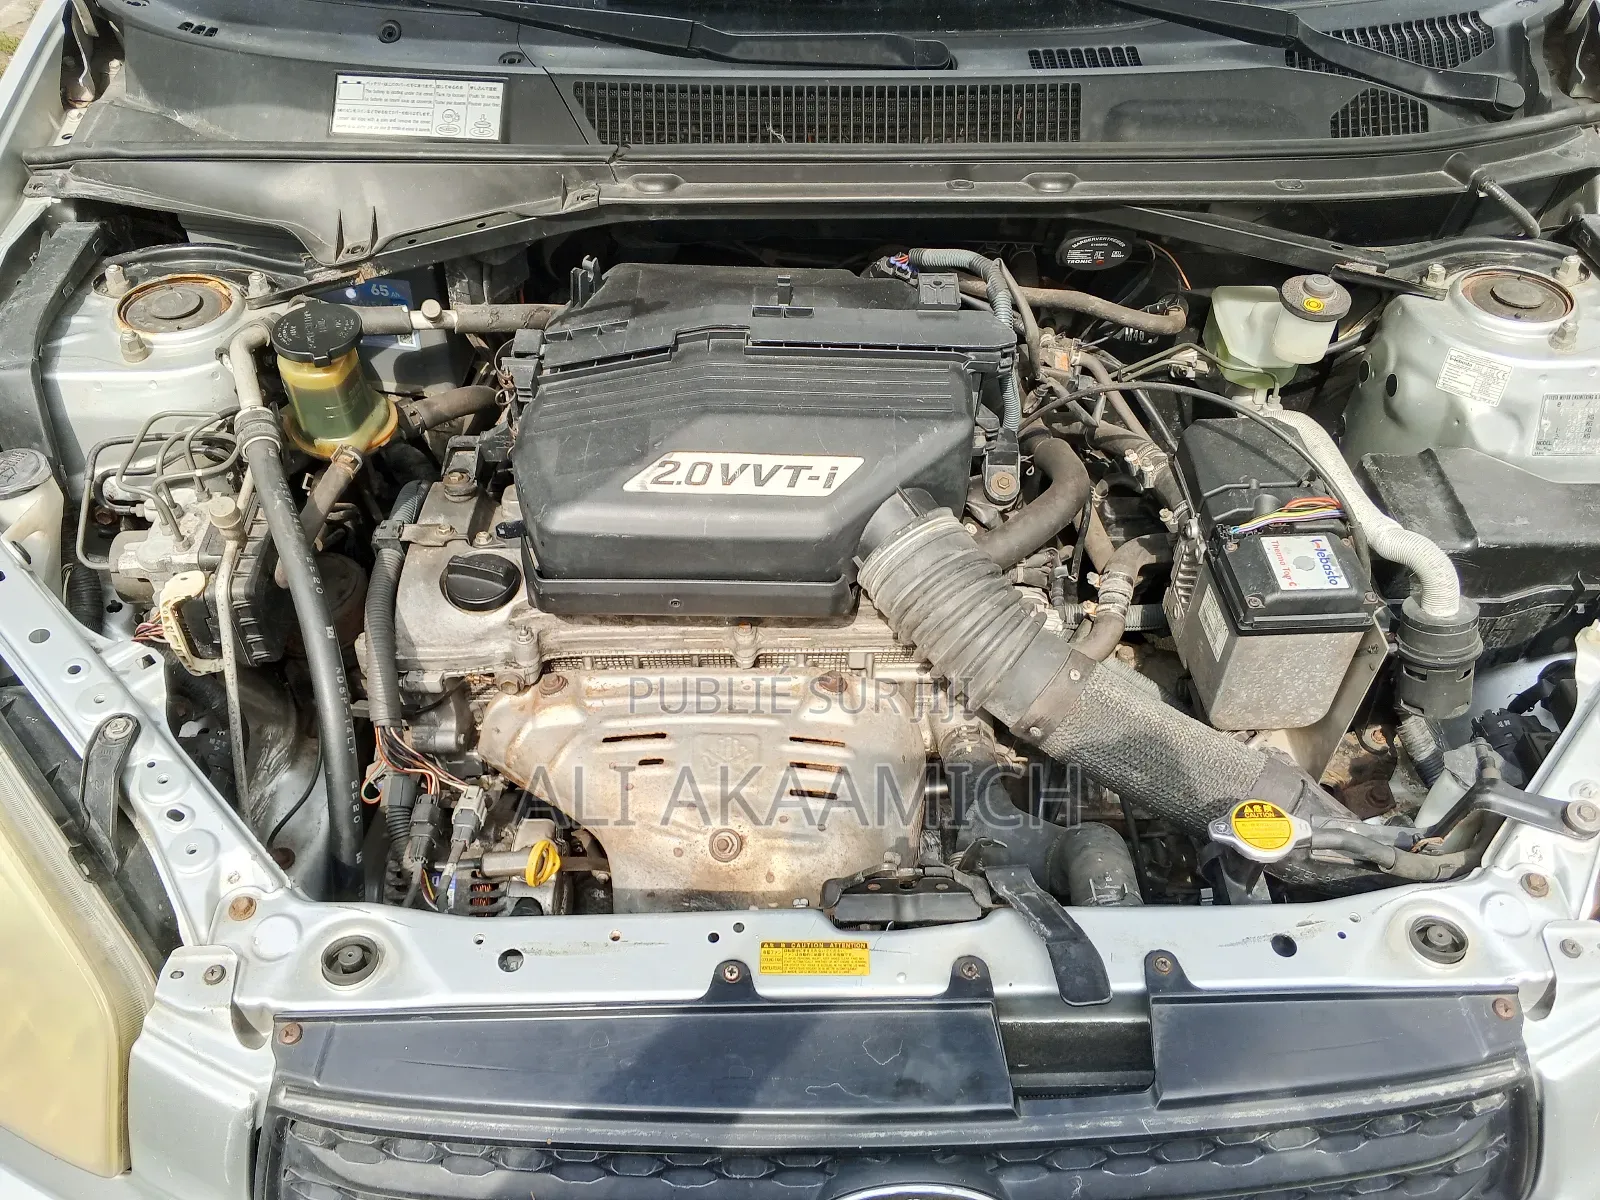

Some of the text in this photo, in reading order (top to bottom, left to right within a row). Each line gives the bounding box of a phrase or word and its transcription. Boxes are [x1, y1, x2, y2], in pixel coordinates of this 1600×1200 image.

[371, 283, 389, 297] 65
[1271, 541, 1285, 566] Thermo
[1282, 567, 1292, 581] Top
